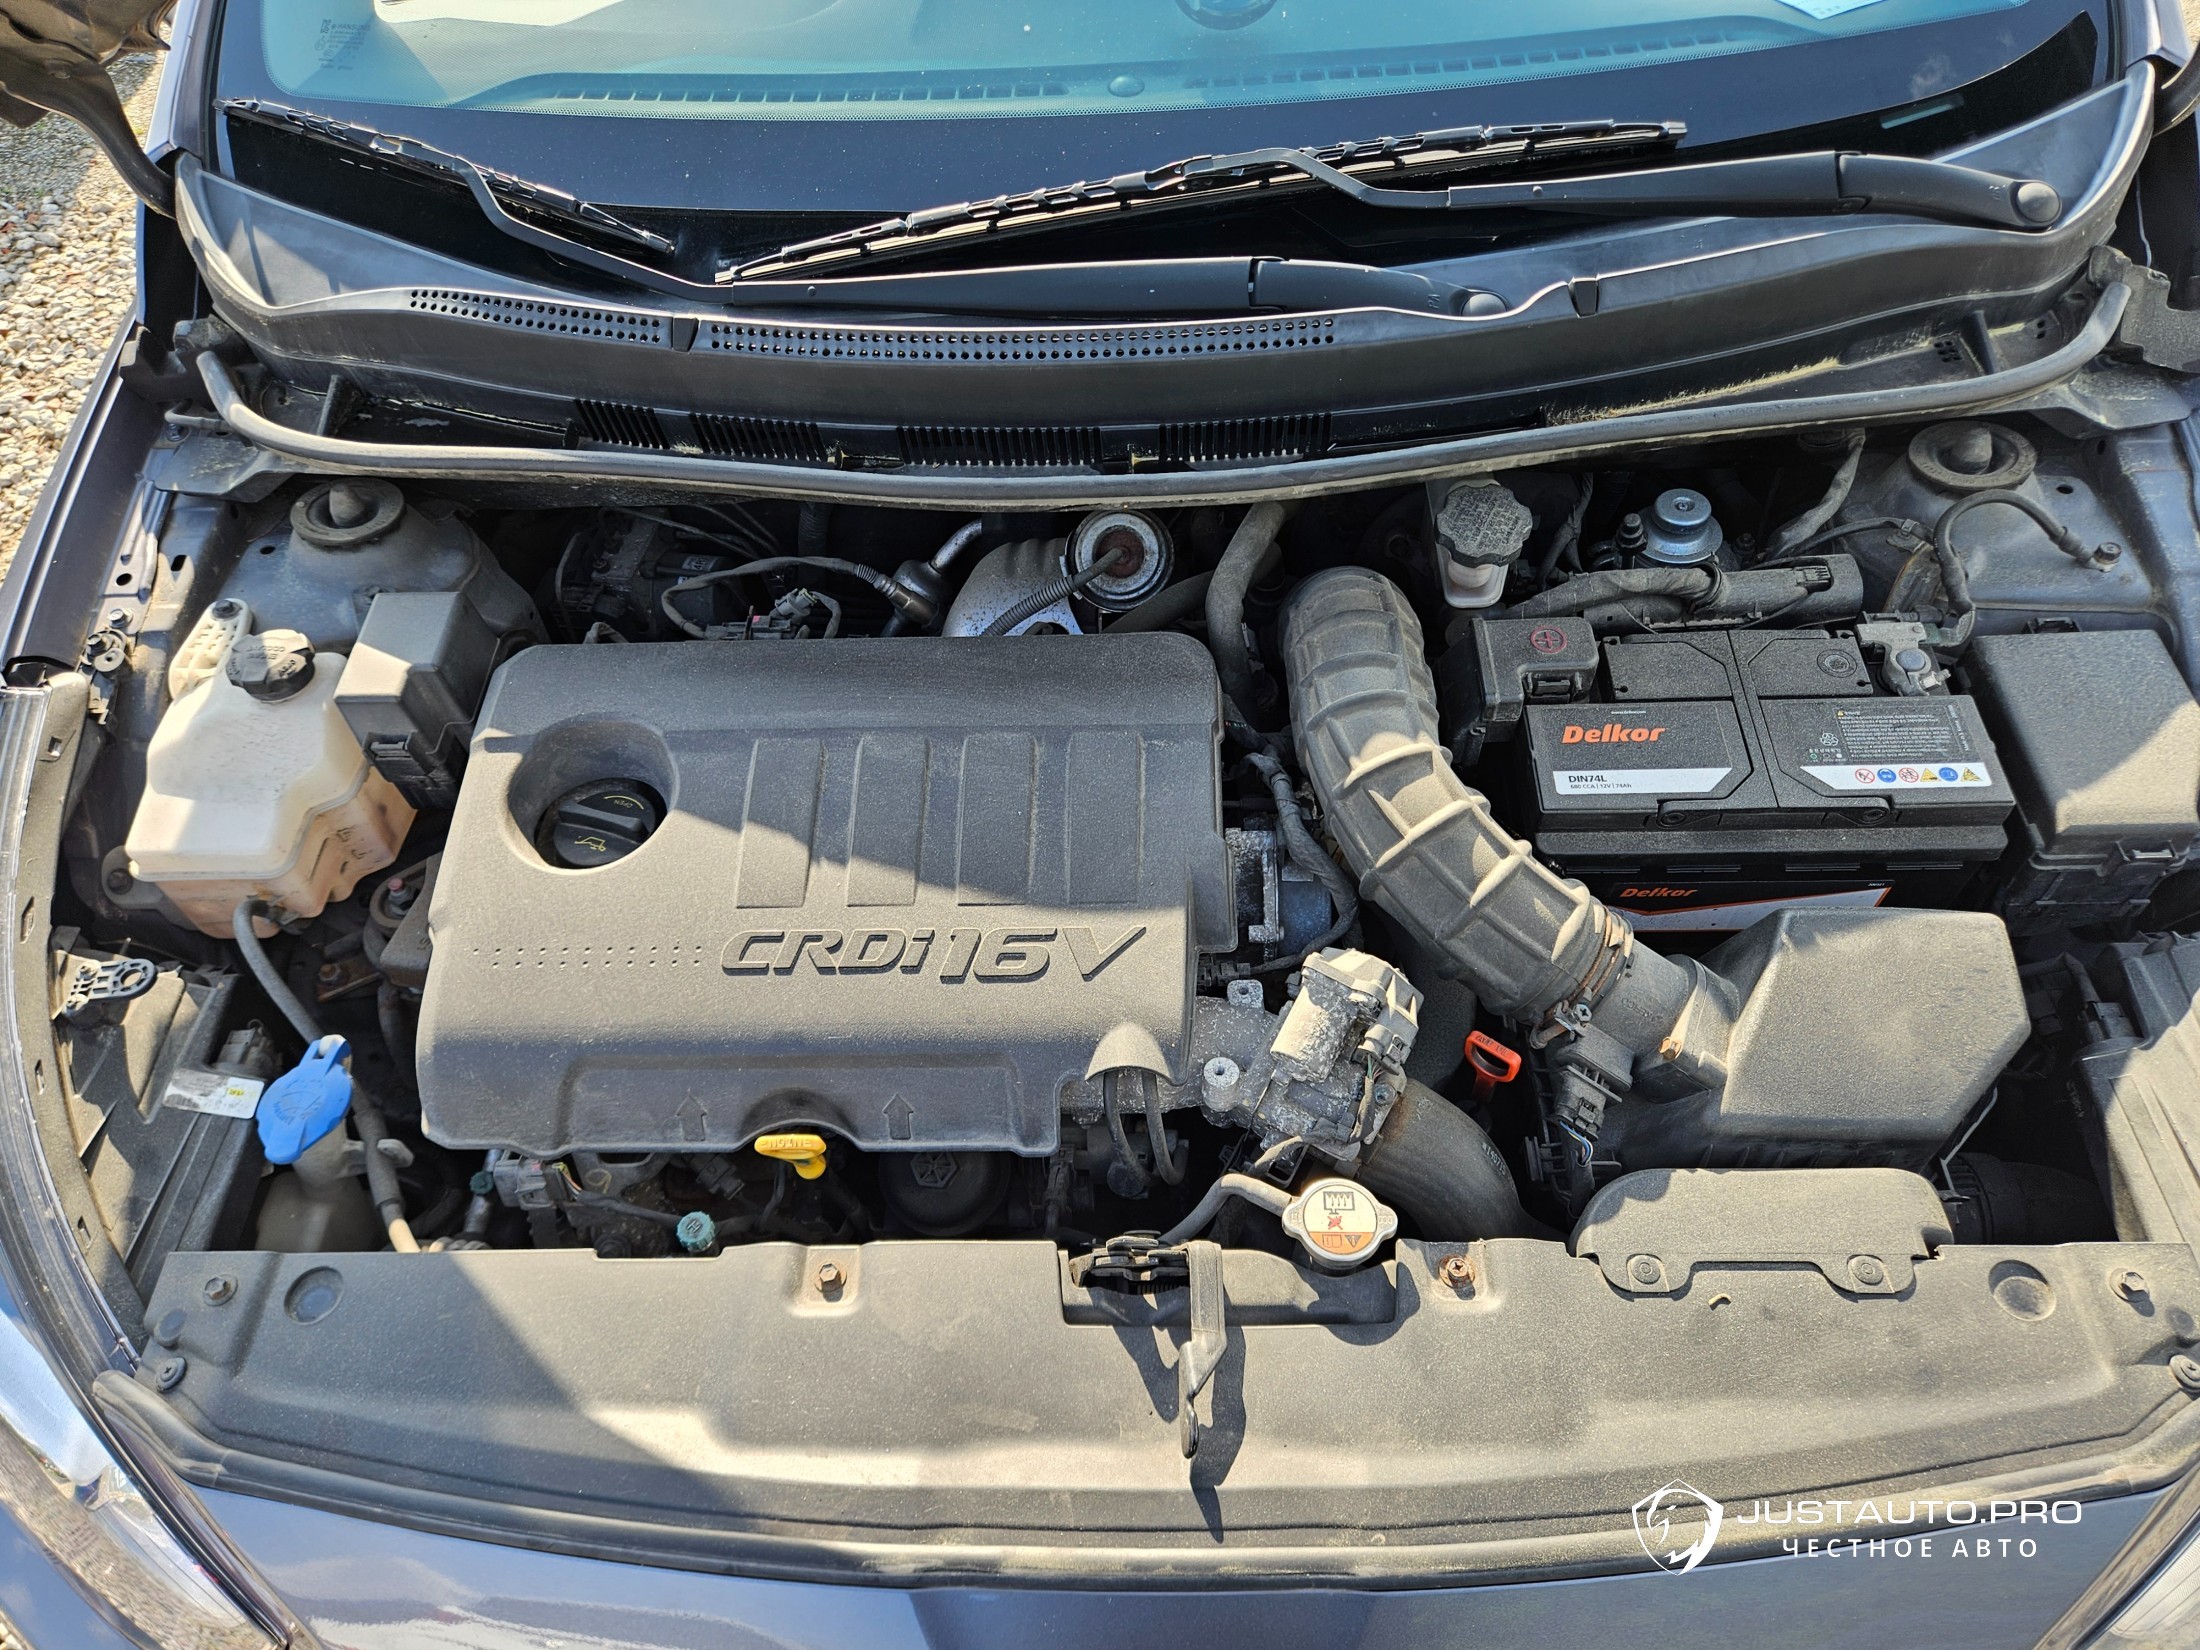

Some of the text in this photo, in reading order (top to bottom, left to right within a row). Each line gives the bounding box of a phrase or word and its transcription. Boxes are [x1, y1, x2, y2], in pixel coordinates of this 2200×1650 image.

[1561, 723, 1666, 744] Delkor
[1568, 774, 1608, 784] DIN74L
[613, 799, 634, 809] OPEN
[1619, 887, 1698, 898] Delkor
[720, 926, 1147, 984] CRDi 16V
[760, 1138, 812, 1148] ENGINE
